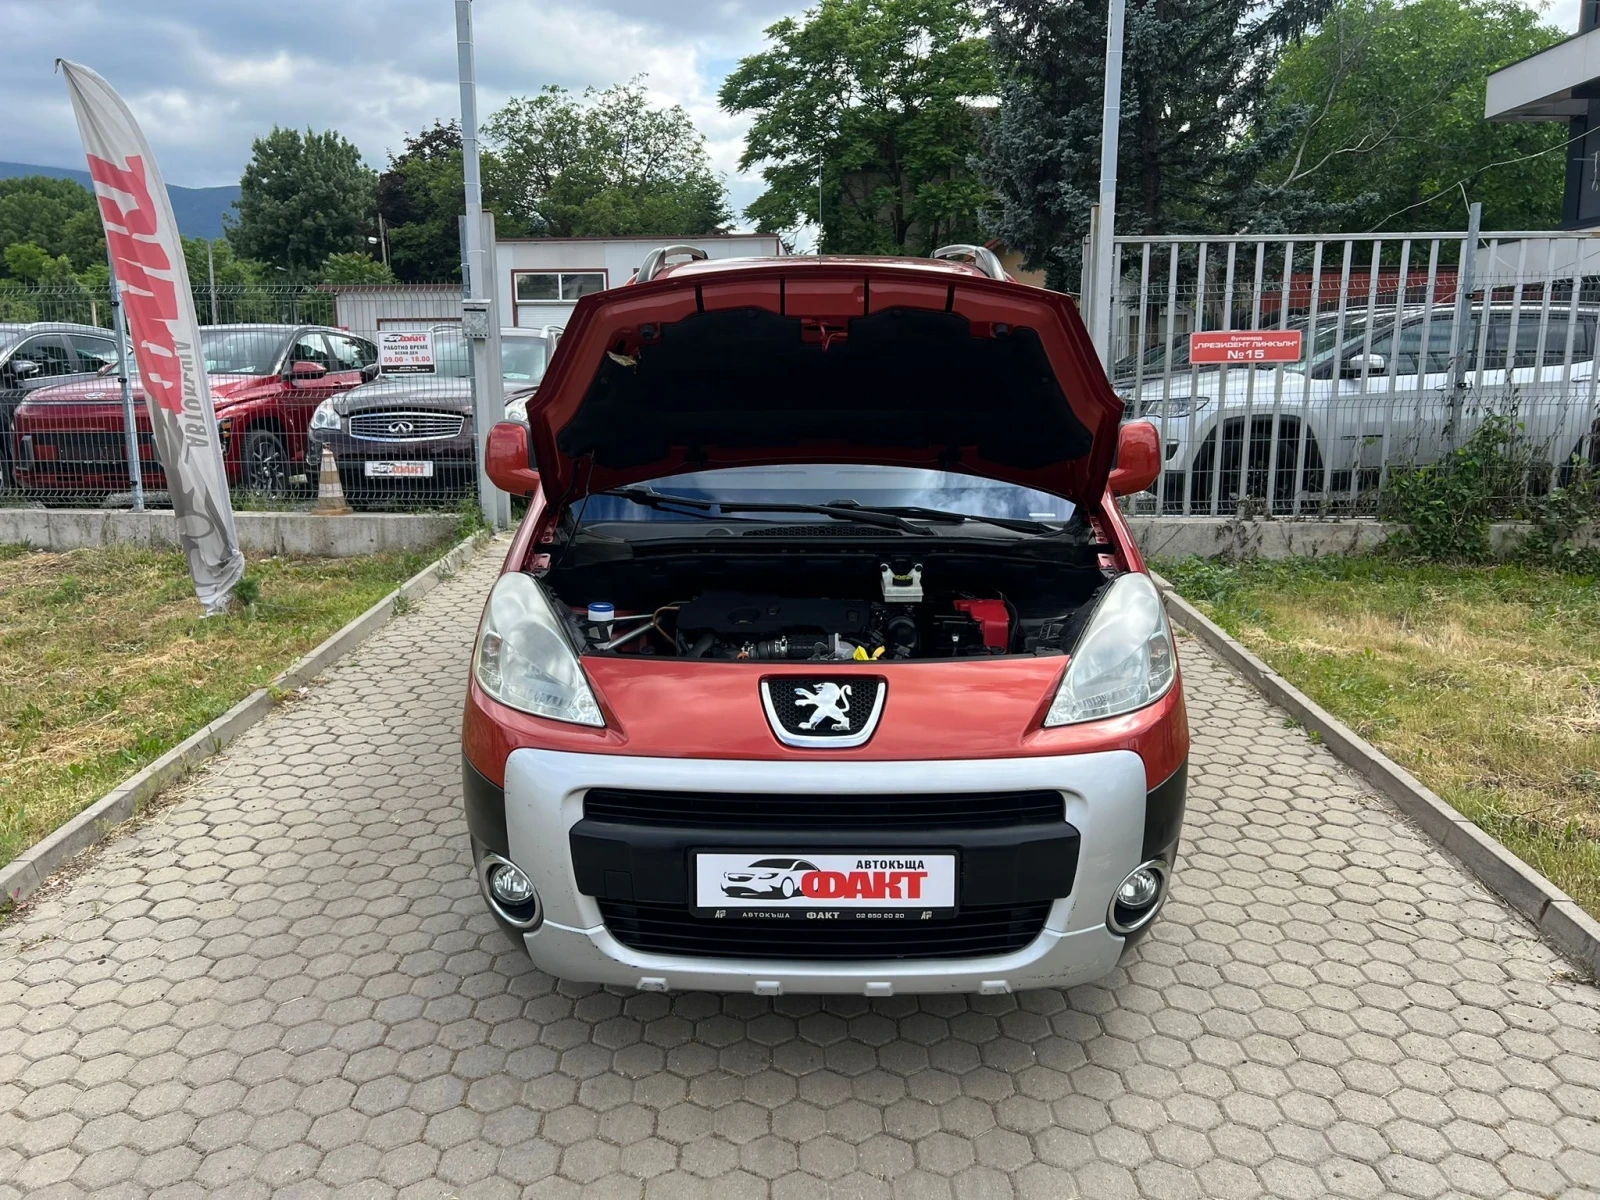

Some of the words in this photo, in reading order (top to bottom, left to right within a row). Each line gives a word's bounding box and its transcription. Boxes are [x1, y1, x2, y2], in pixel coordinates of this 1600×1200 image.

[856, 860, 925, 871] АВТОКЪЩА
[801, 871, 929, 899] ФАКТ
[806, 911, 840, 919] ФАКТ
